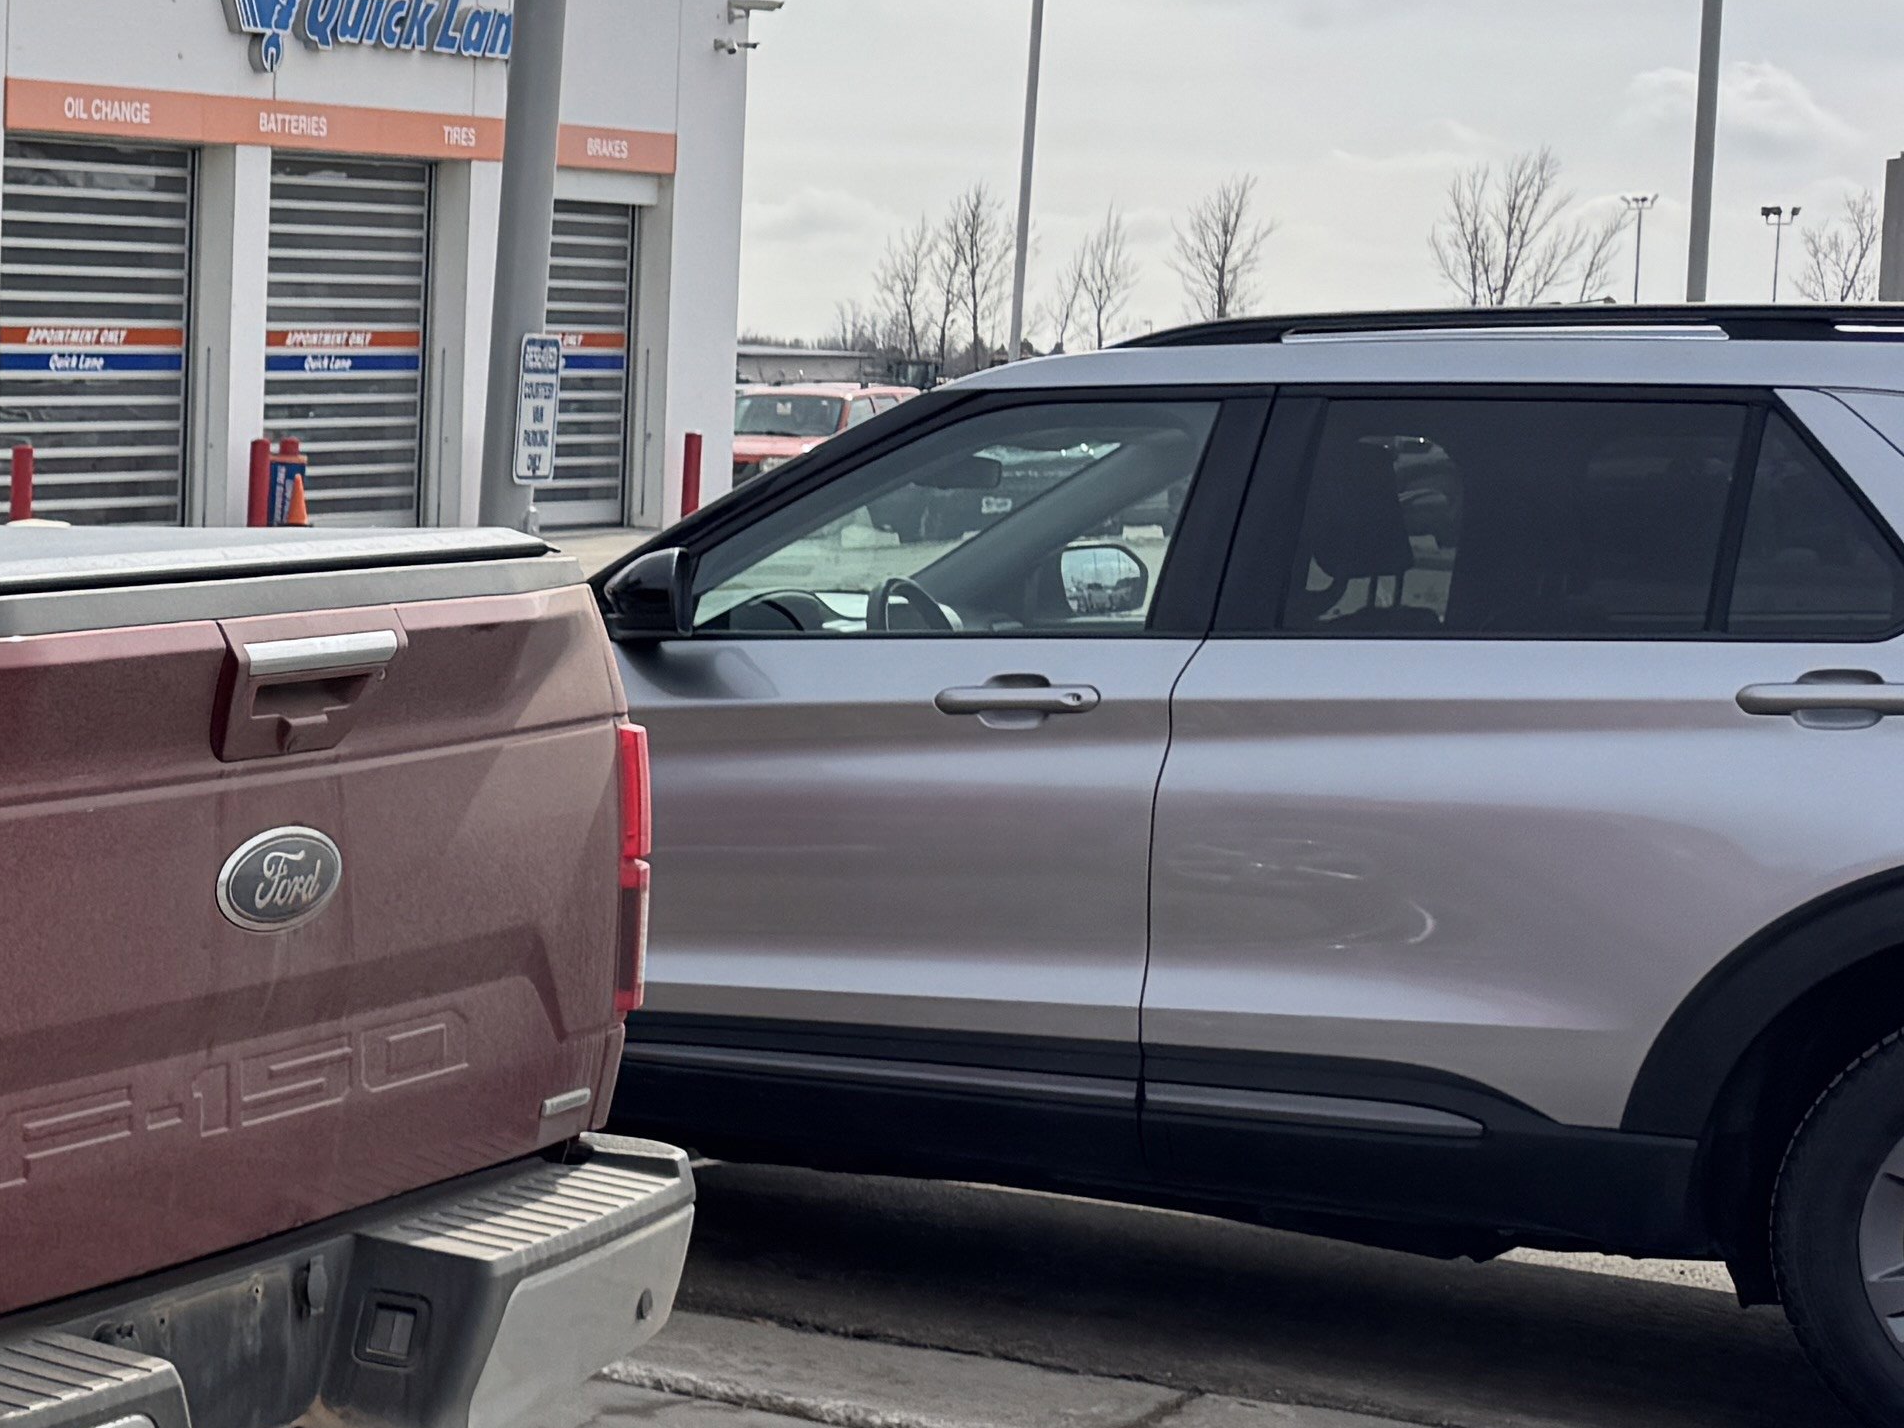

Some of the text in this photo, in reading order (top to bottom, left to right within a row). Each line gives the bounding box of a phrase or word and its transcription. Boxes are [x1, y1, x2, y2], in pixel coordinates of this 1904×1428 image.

[64, 96, 150, 124] OIL CHANGE
[259, 112, 328, 137] BATTERIES
[443, 125, 476, 147] TIRES
[586, 137, 628, 159] BRAKES
[26, 327, 128, 345] APPOINTMENT ONLY
[254, 850, 321, 909] Ford
